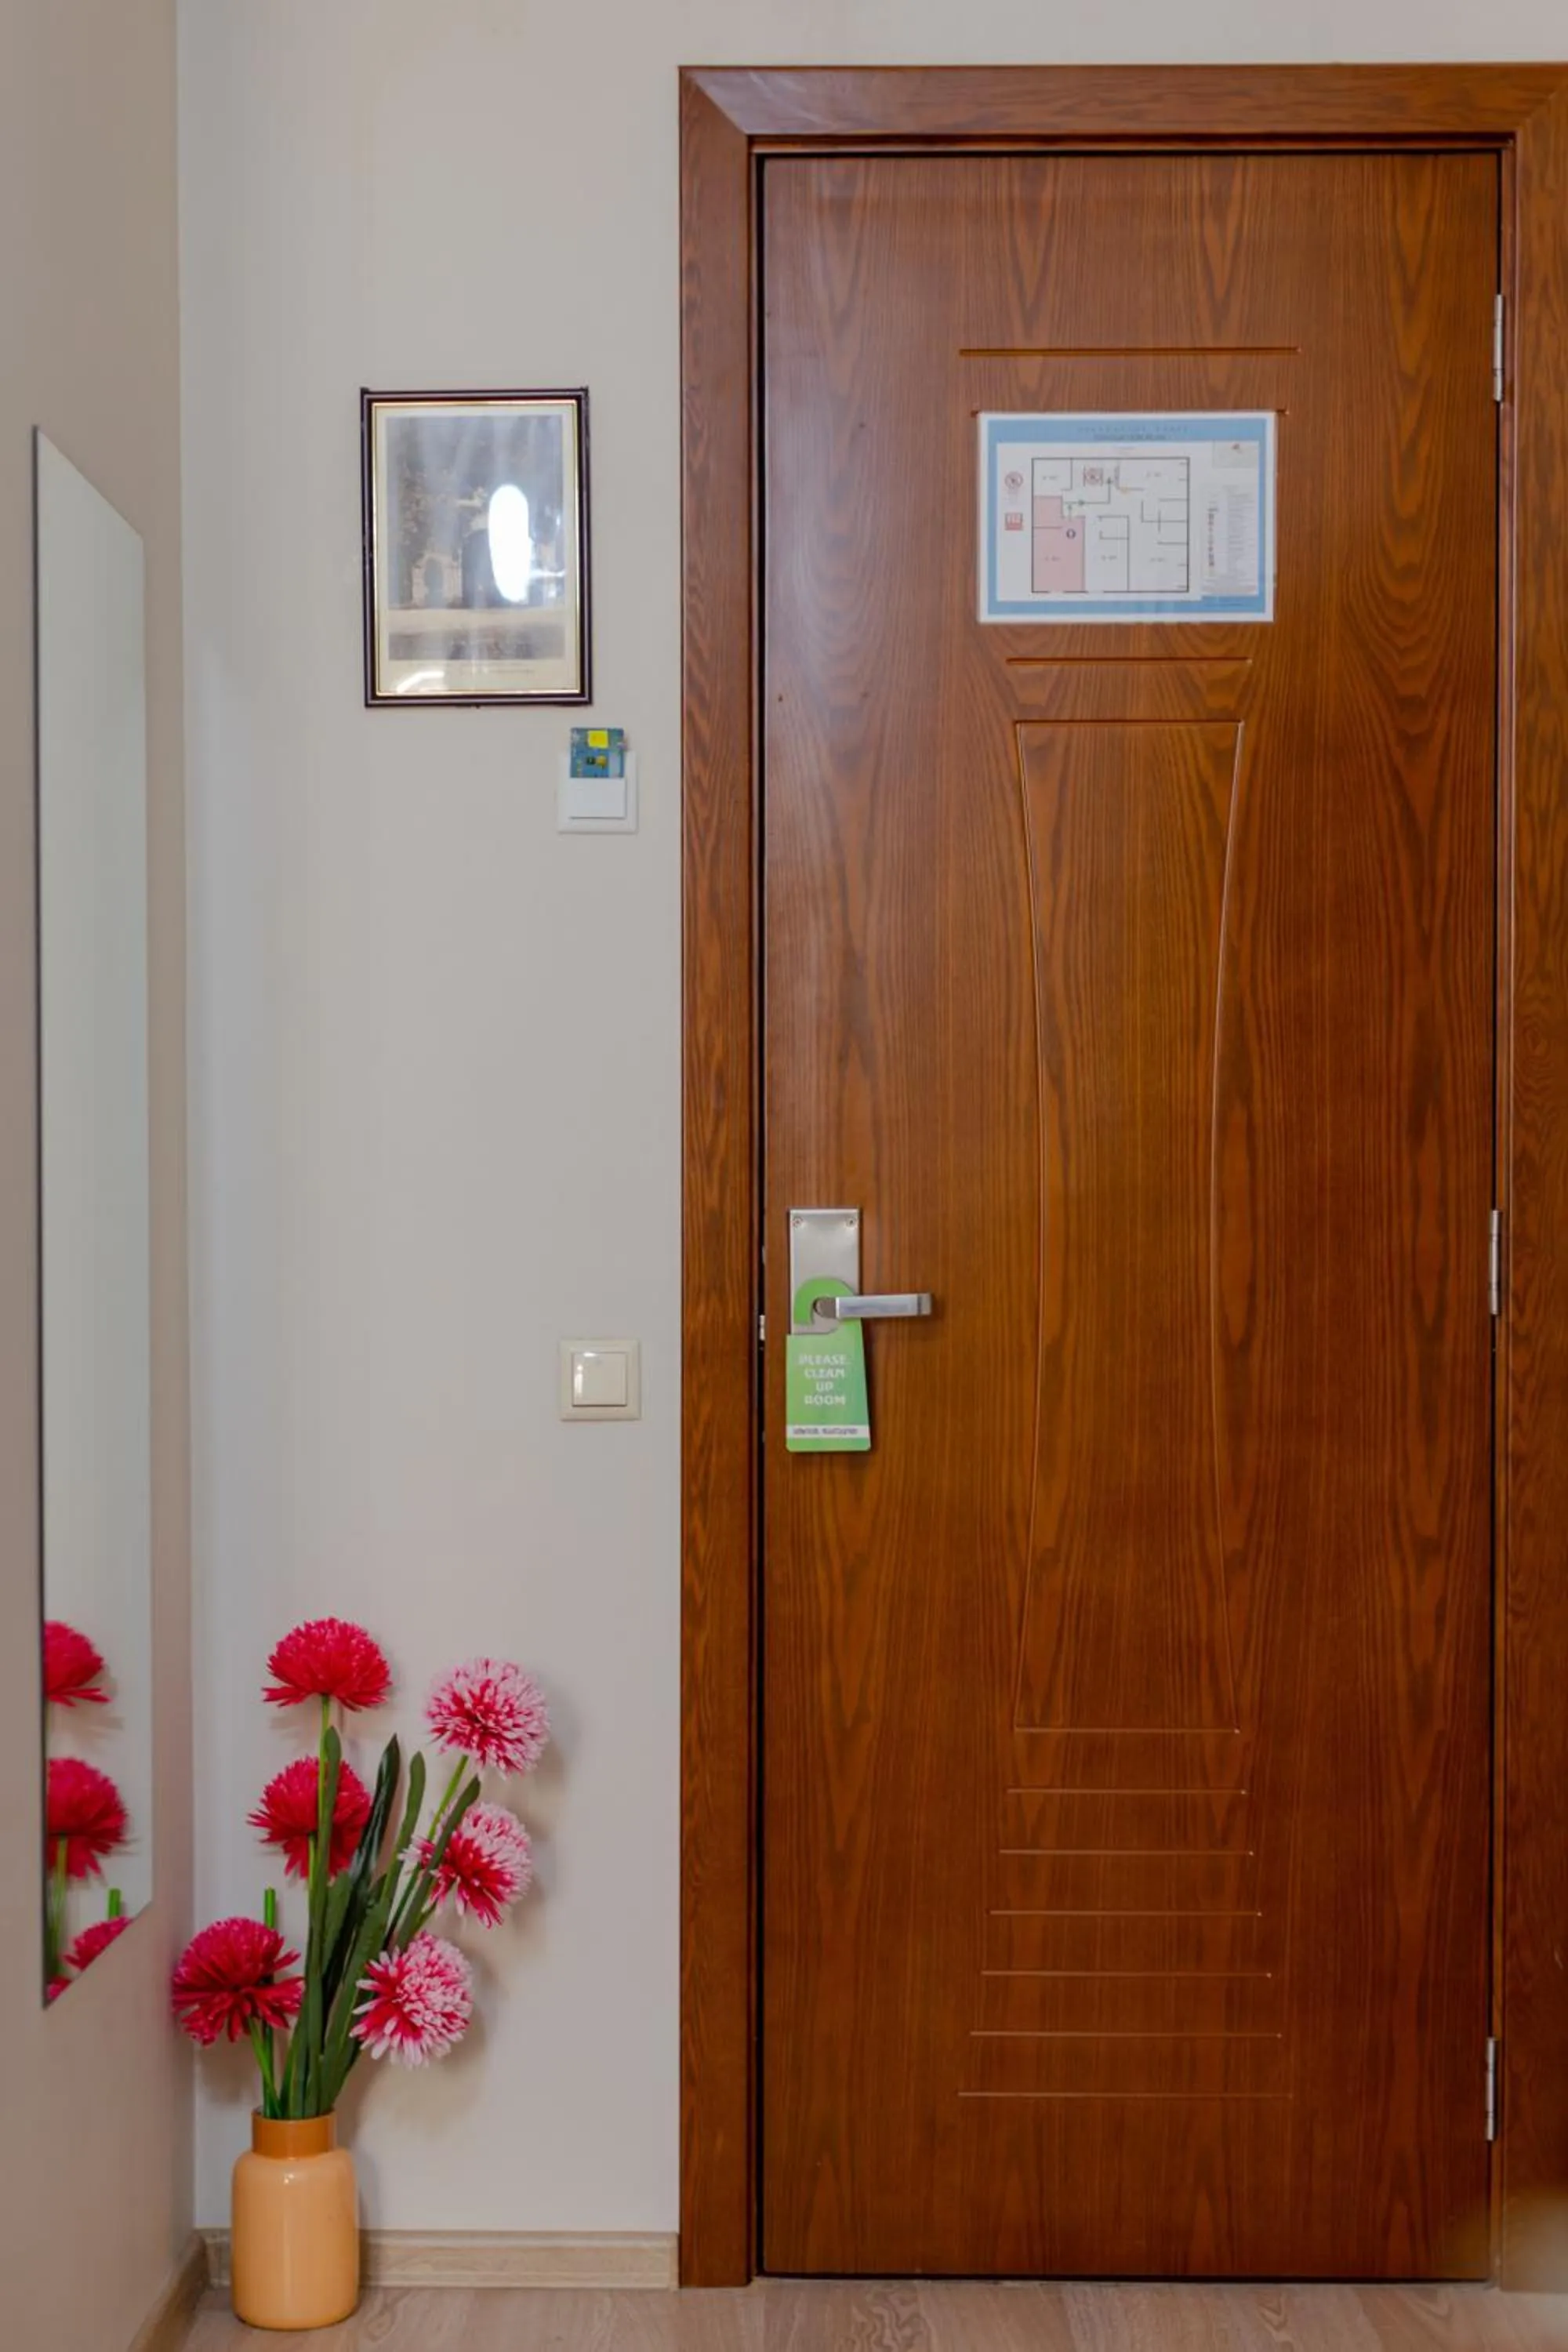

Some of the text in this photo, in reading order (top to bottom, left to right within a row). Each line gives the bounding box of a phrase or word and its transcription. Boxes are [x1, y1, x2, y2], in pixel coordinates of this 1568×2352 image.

[798, 1354, 848, 1365] PLEASE
[815, 1381, 834, 1392] UP
[804, 1395, 846, 1406] ROOM
